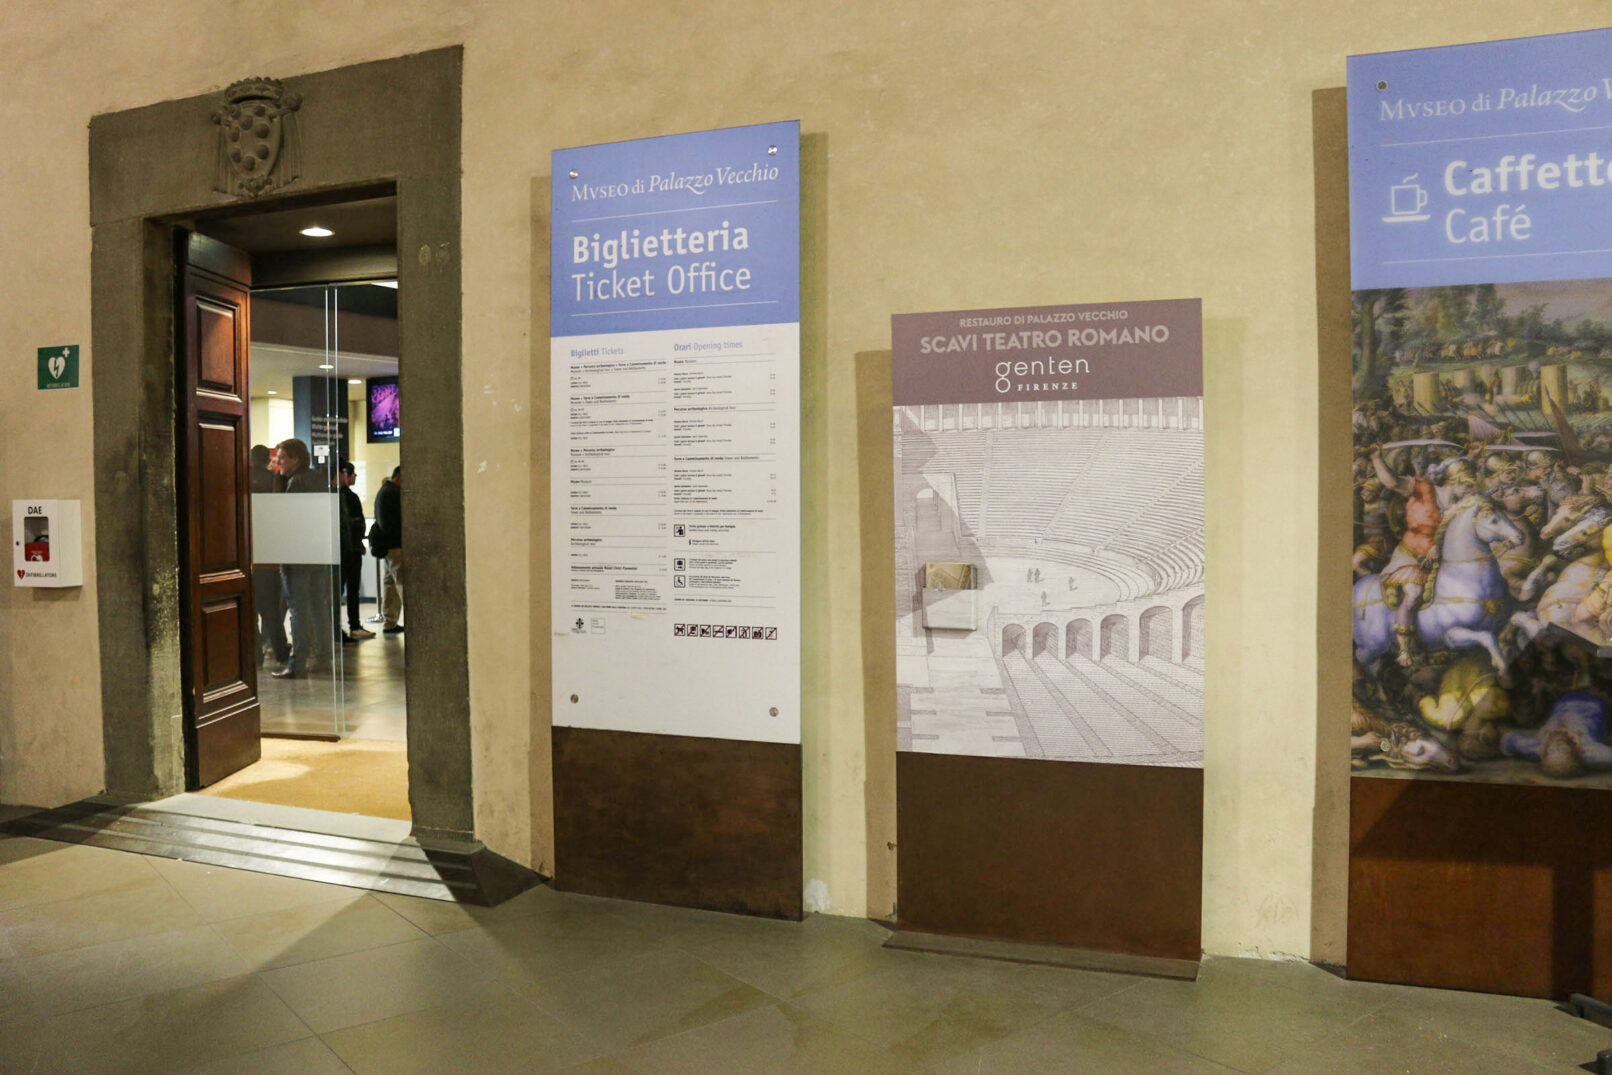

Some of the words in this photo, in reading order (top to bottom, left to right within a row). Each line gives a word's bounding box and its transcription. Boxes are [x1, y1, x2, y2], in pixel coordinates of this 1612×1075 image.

[1471, 92, 1492, 112] di
[1497, 83, 1598, 113] Palazzo
[631, 178, 645, 194] di
[648, 172, 714, 195] Palazzo
[716, 162, 779, 185] Vecchio
[1444, 152, 1612, 196] Caffett
[1446, 204, 1532, 243] Café
[573, 221, 749, 268] Biglietteria
[571, 269, 655, 301] Ticket
[667, 261, 752, 295] Office
[959, 316, 1012, 328] RESTAURO
[1014, 314, 1025, 325] DI
[1027, 312, 1076, 325] PALAZZO
[1078, 309, 1129, 322] VECCHIO
[920, 334, 977, 354] SCAVI
[982, 329, 1063, 350] TEATRO
[1068, 324, 1170, 347] ROMANO
[995, 356, 1091, 393] genten
[1017, 381, 1079, 392] FIRENZE
[28, 506, 43, 514] DAE
